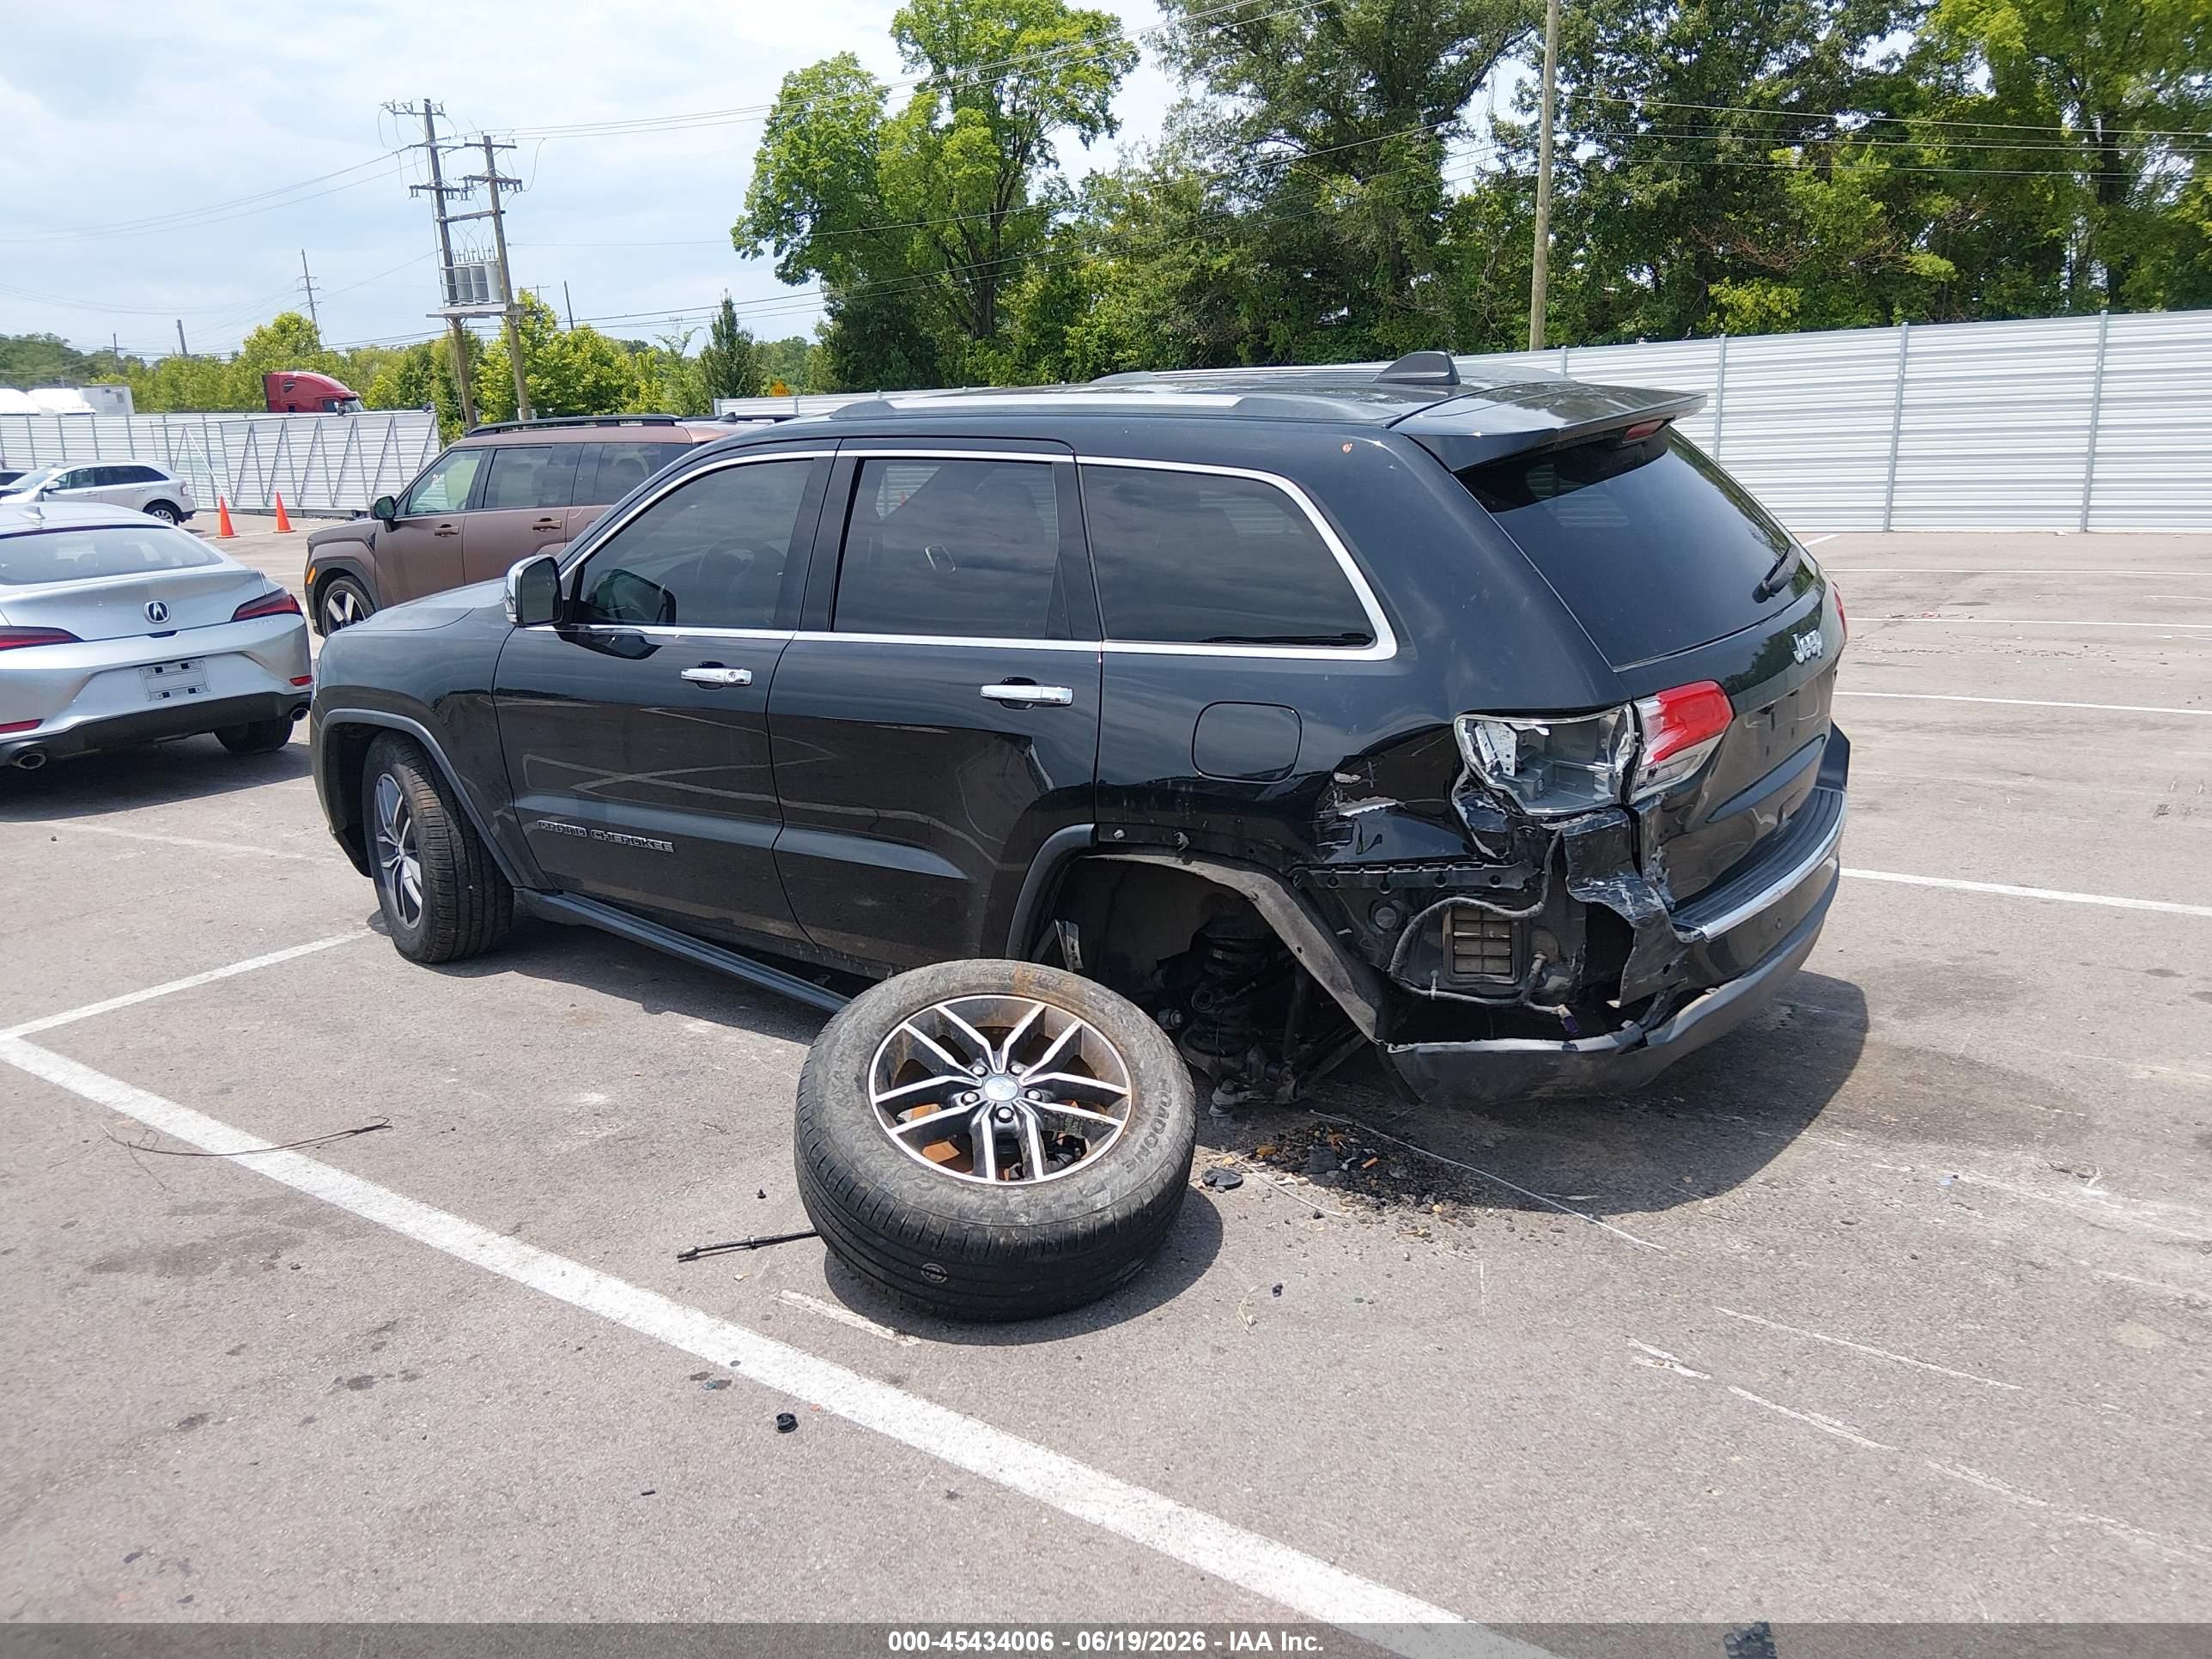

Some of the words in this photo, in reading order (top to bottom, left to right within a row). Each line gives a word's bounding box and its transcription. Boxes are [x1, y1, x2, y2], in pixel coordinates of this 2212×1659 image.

[1791, 629, 1823, 664] Jeep
[537, 819, 587, 838] GRAND
[591, 829, 674, 853] CHEROKEE
